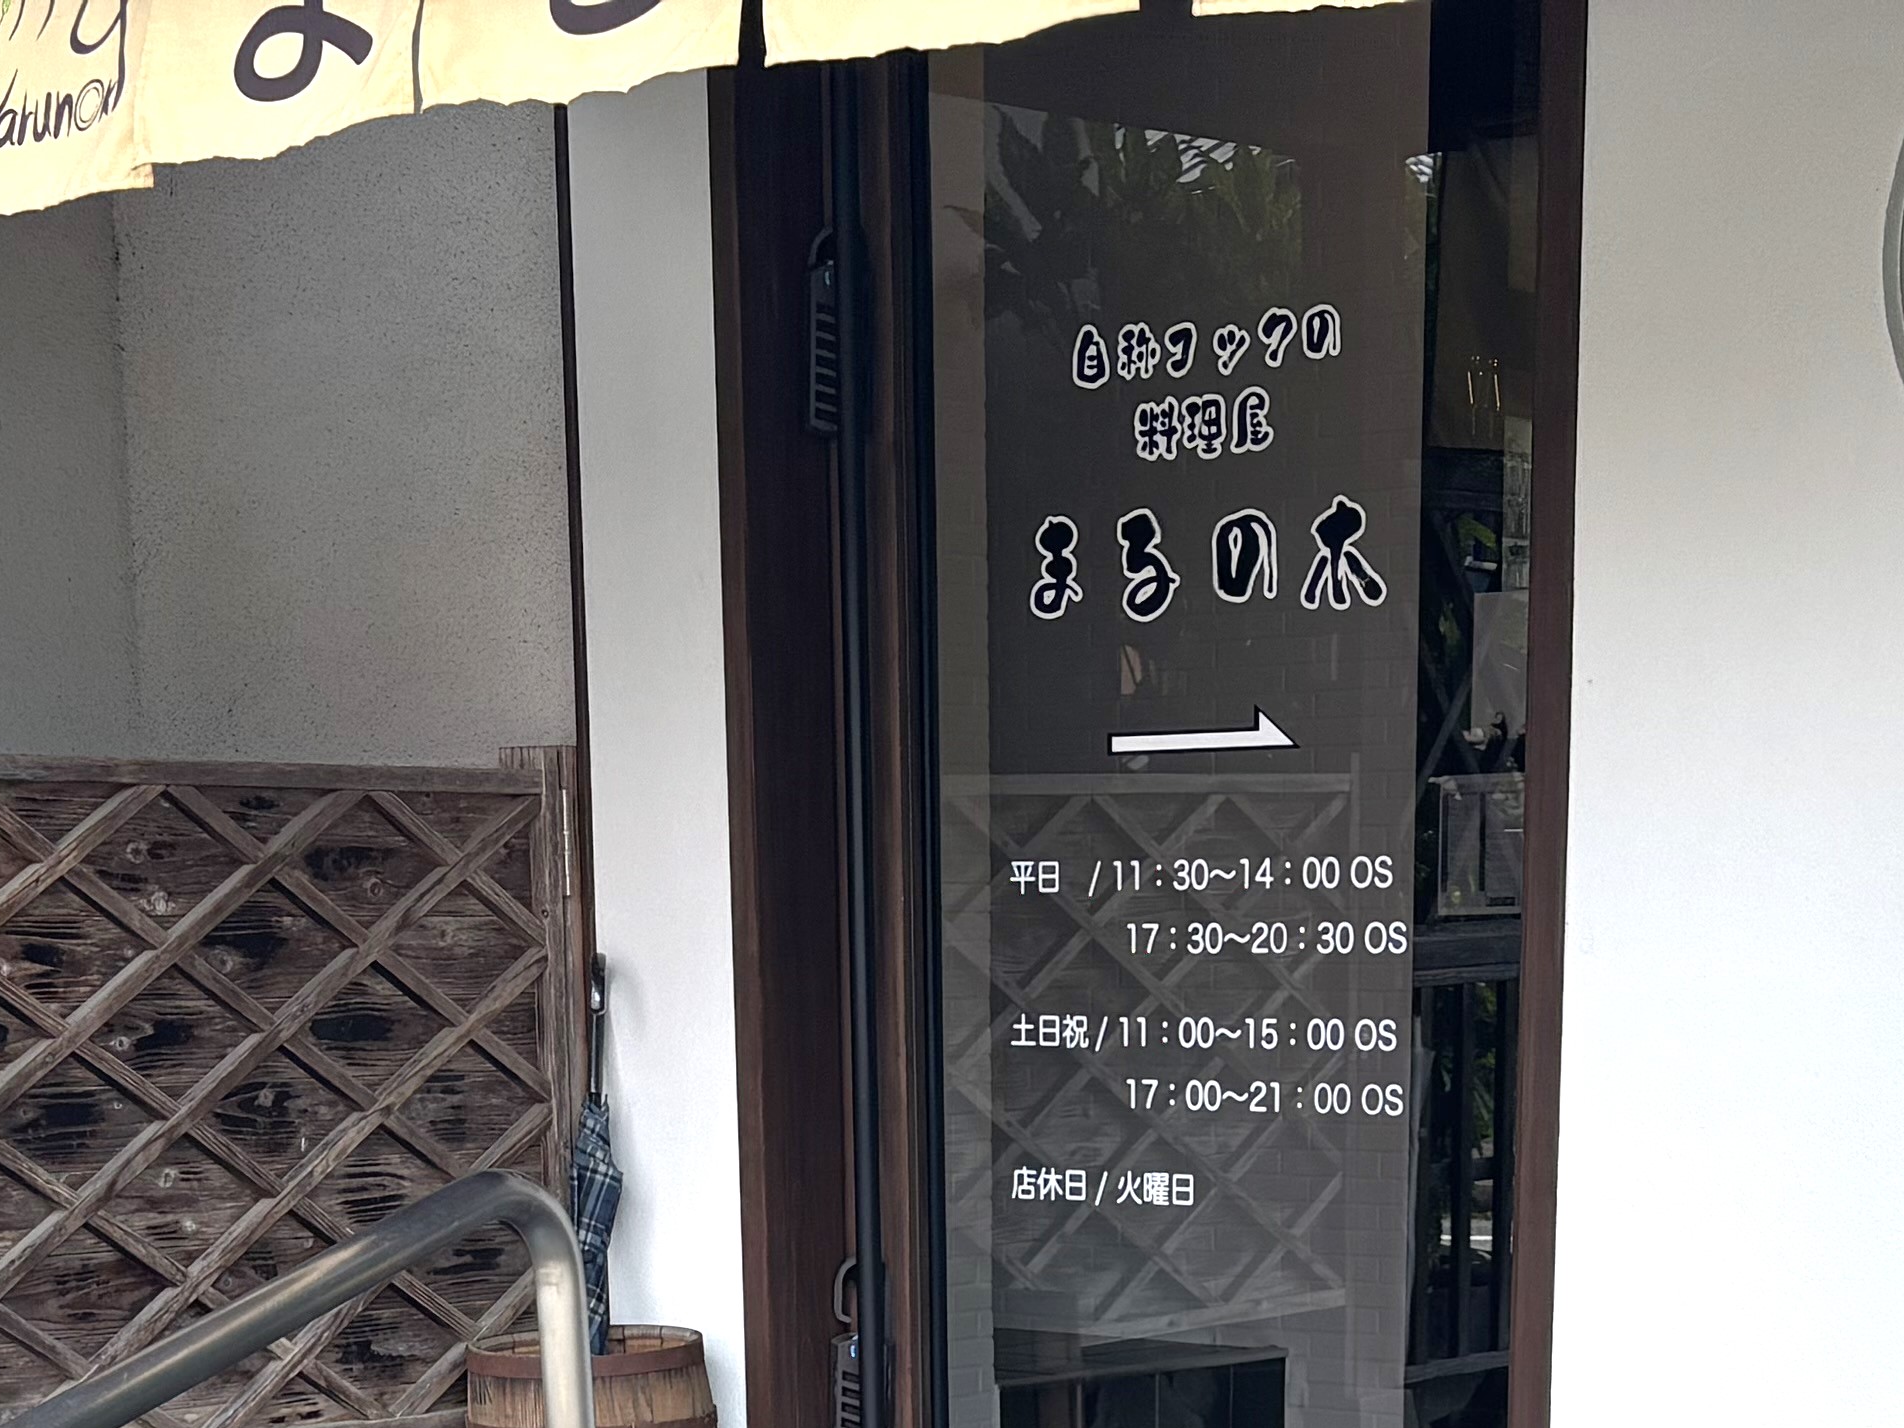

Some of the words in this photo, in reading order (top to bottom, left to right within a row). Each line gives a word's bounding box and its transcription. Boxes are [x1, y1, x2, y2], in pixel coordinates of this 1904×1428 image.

[1072, 304, 1341, 389] 自称コックの
[1133, 385, 1274, 462] 料理屋
[1029, 494, 1387, 623] まるの木
[1009, 860, 1060, 895] 平日
[1350, 855, 1393, 889] OS
[1364, 921, 1408, 955] OS
[1354, 1018, 1397, 1052] OS
[1361, 1083, 1404, 1117] OS
